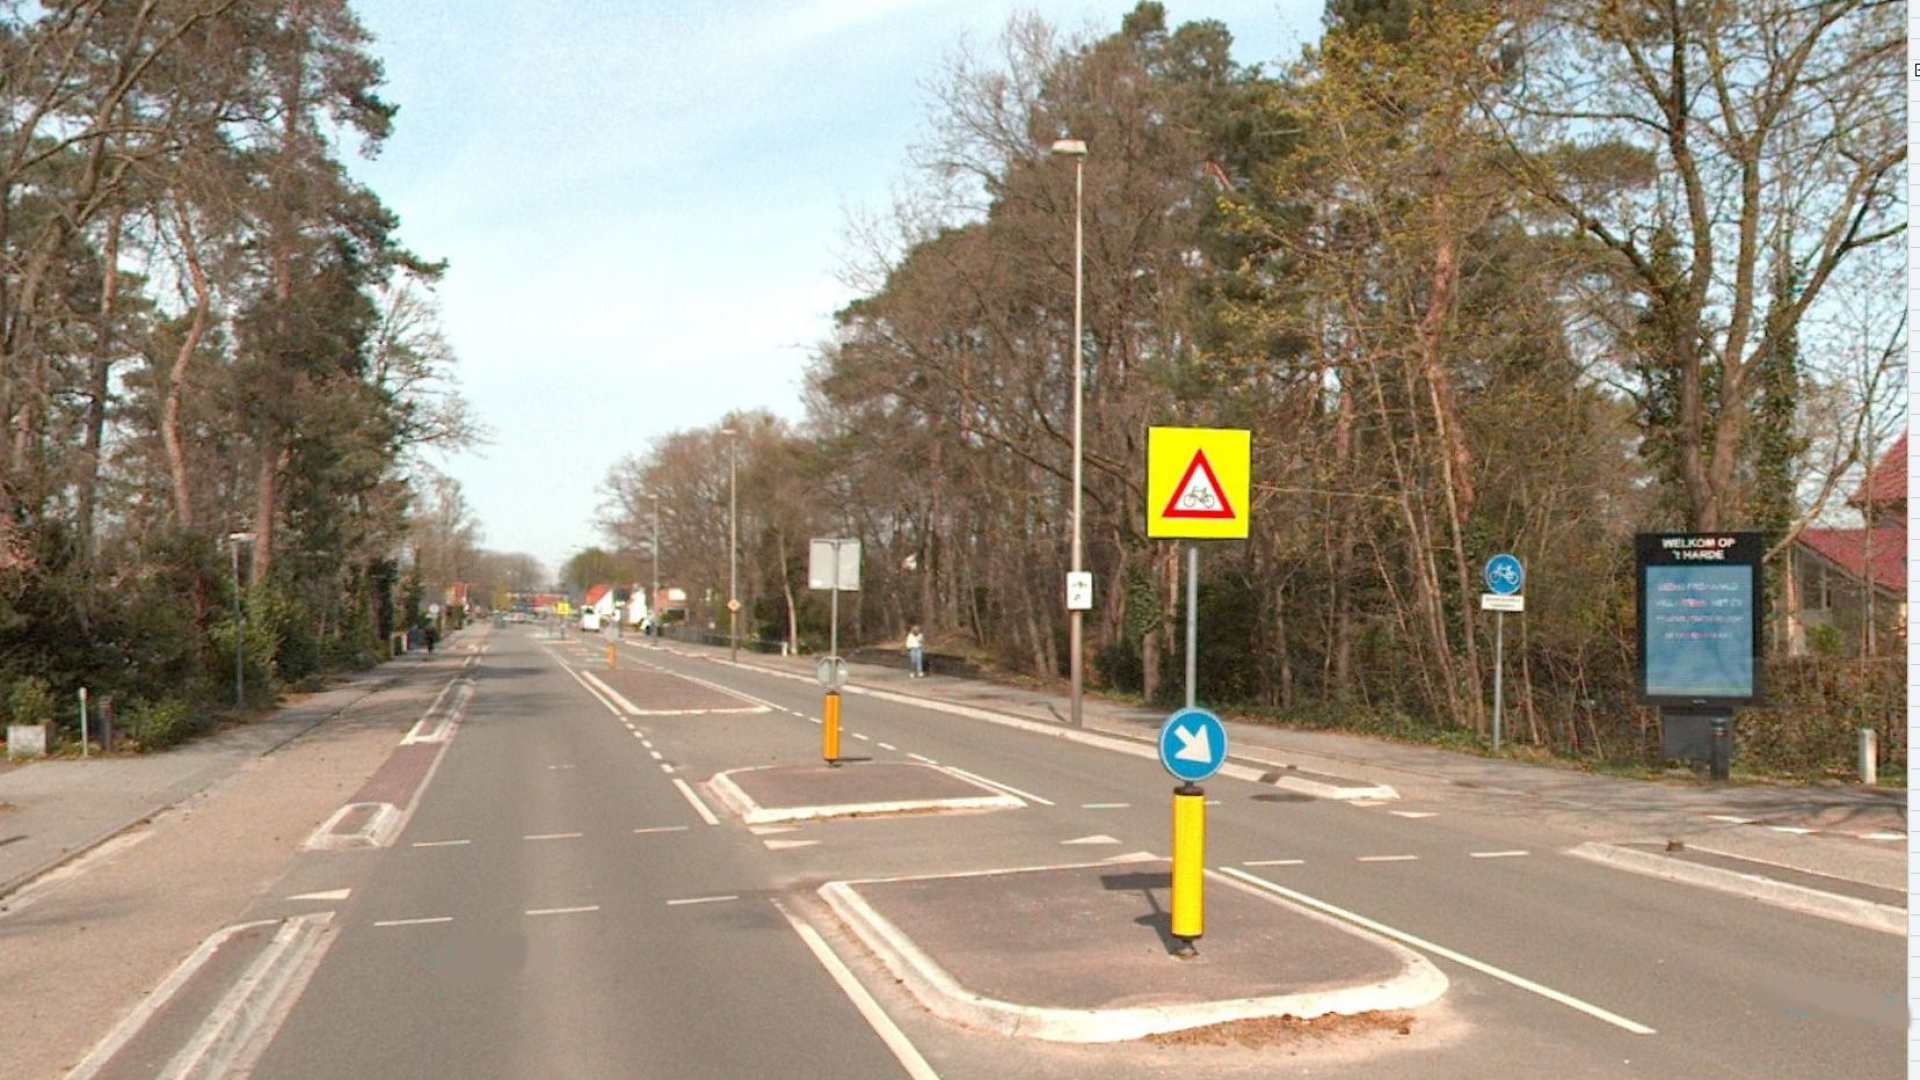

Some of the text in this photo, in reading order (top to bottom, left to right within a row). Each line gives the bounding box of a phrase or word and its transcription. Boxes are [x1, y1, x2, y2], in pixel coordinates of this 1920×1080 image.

[1662, 538, 1736, 548] WELKOM OP
[1682, 549, 1725, 560] HARDE
